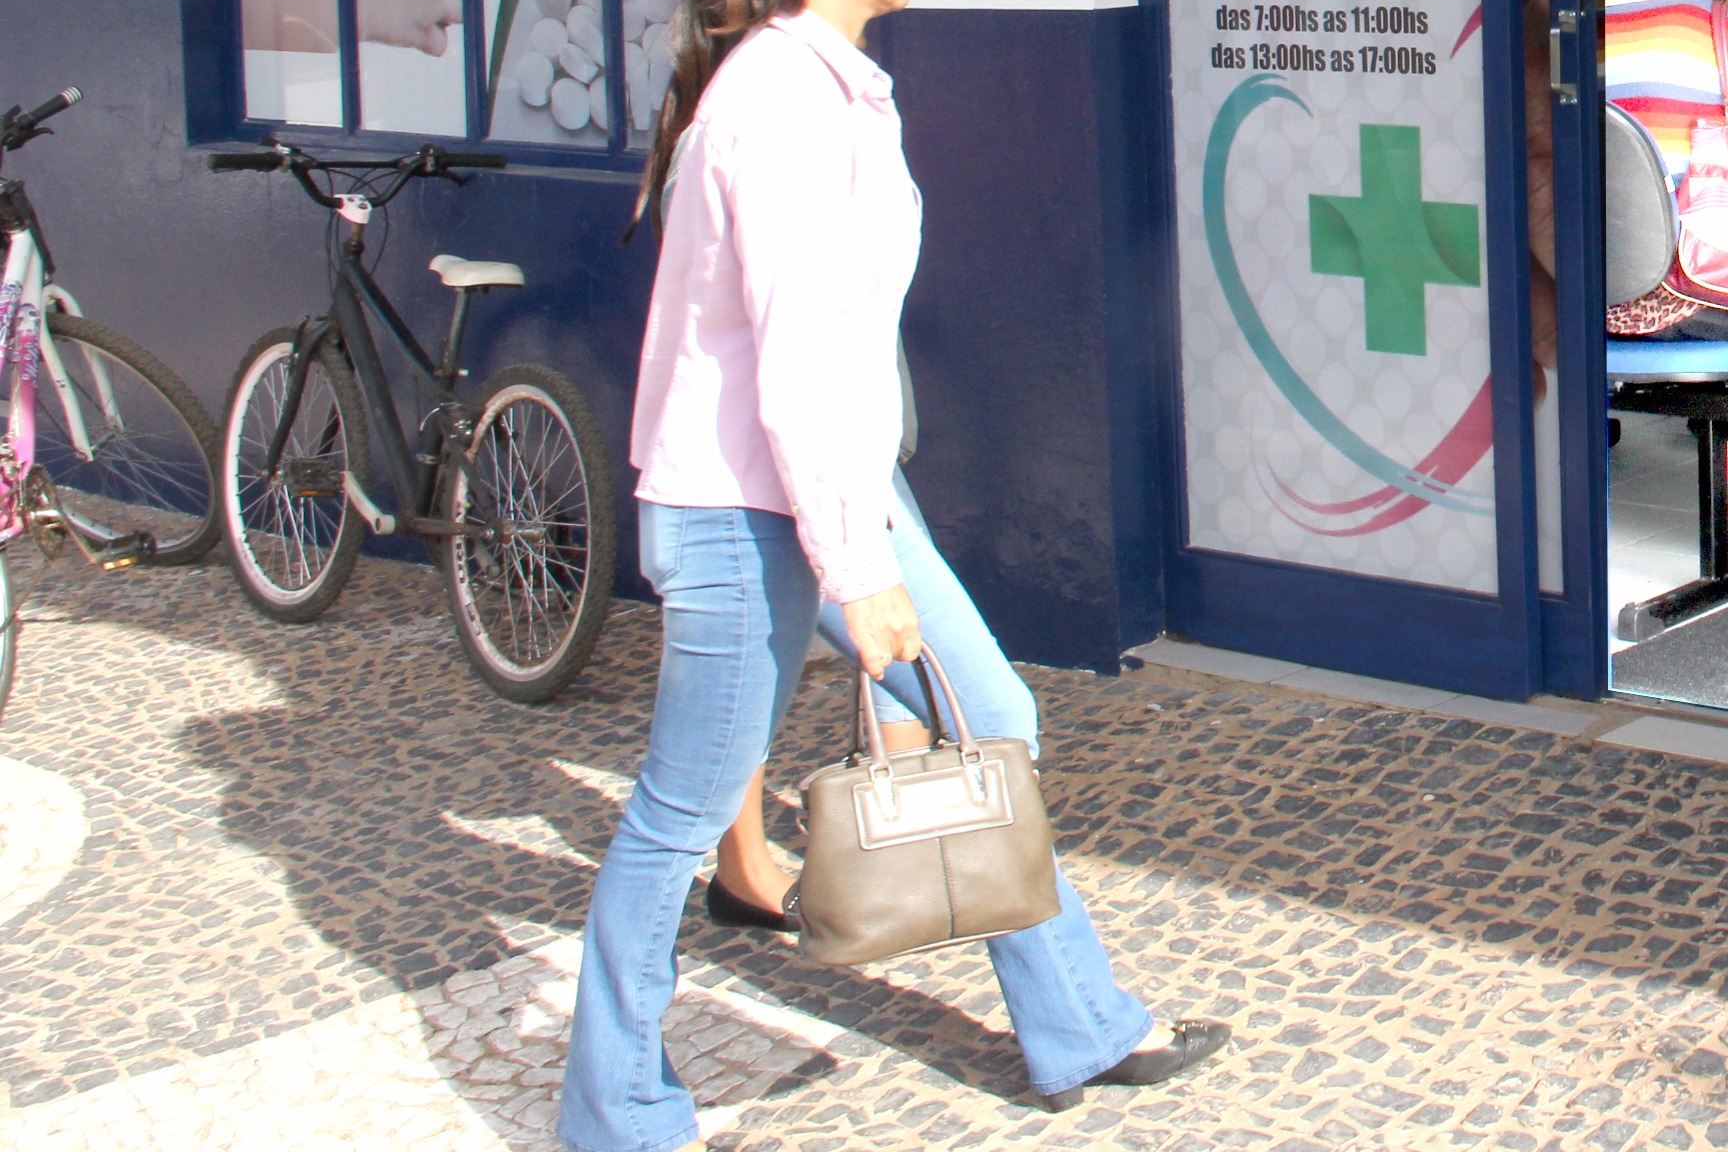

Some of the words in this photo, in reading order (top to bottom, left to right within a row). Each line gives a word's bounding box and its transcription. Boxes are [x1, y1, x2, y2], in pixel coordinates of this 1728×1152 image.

[1216, 5, 1250, 31] das
[1254, 5, 1319, 32] 7:00hs
[1323, 10, 1348, 33] as
[1351, 6, 1428, 34] 11:00hs
[1211, 43, 1246, 69] das
[1250, 44, 1327, 72] 13:00hs
[1330, 49, 1355, 73] as
[1358, 46, 1437, 75] 17:00hs
